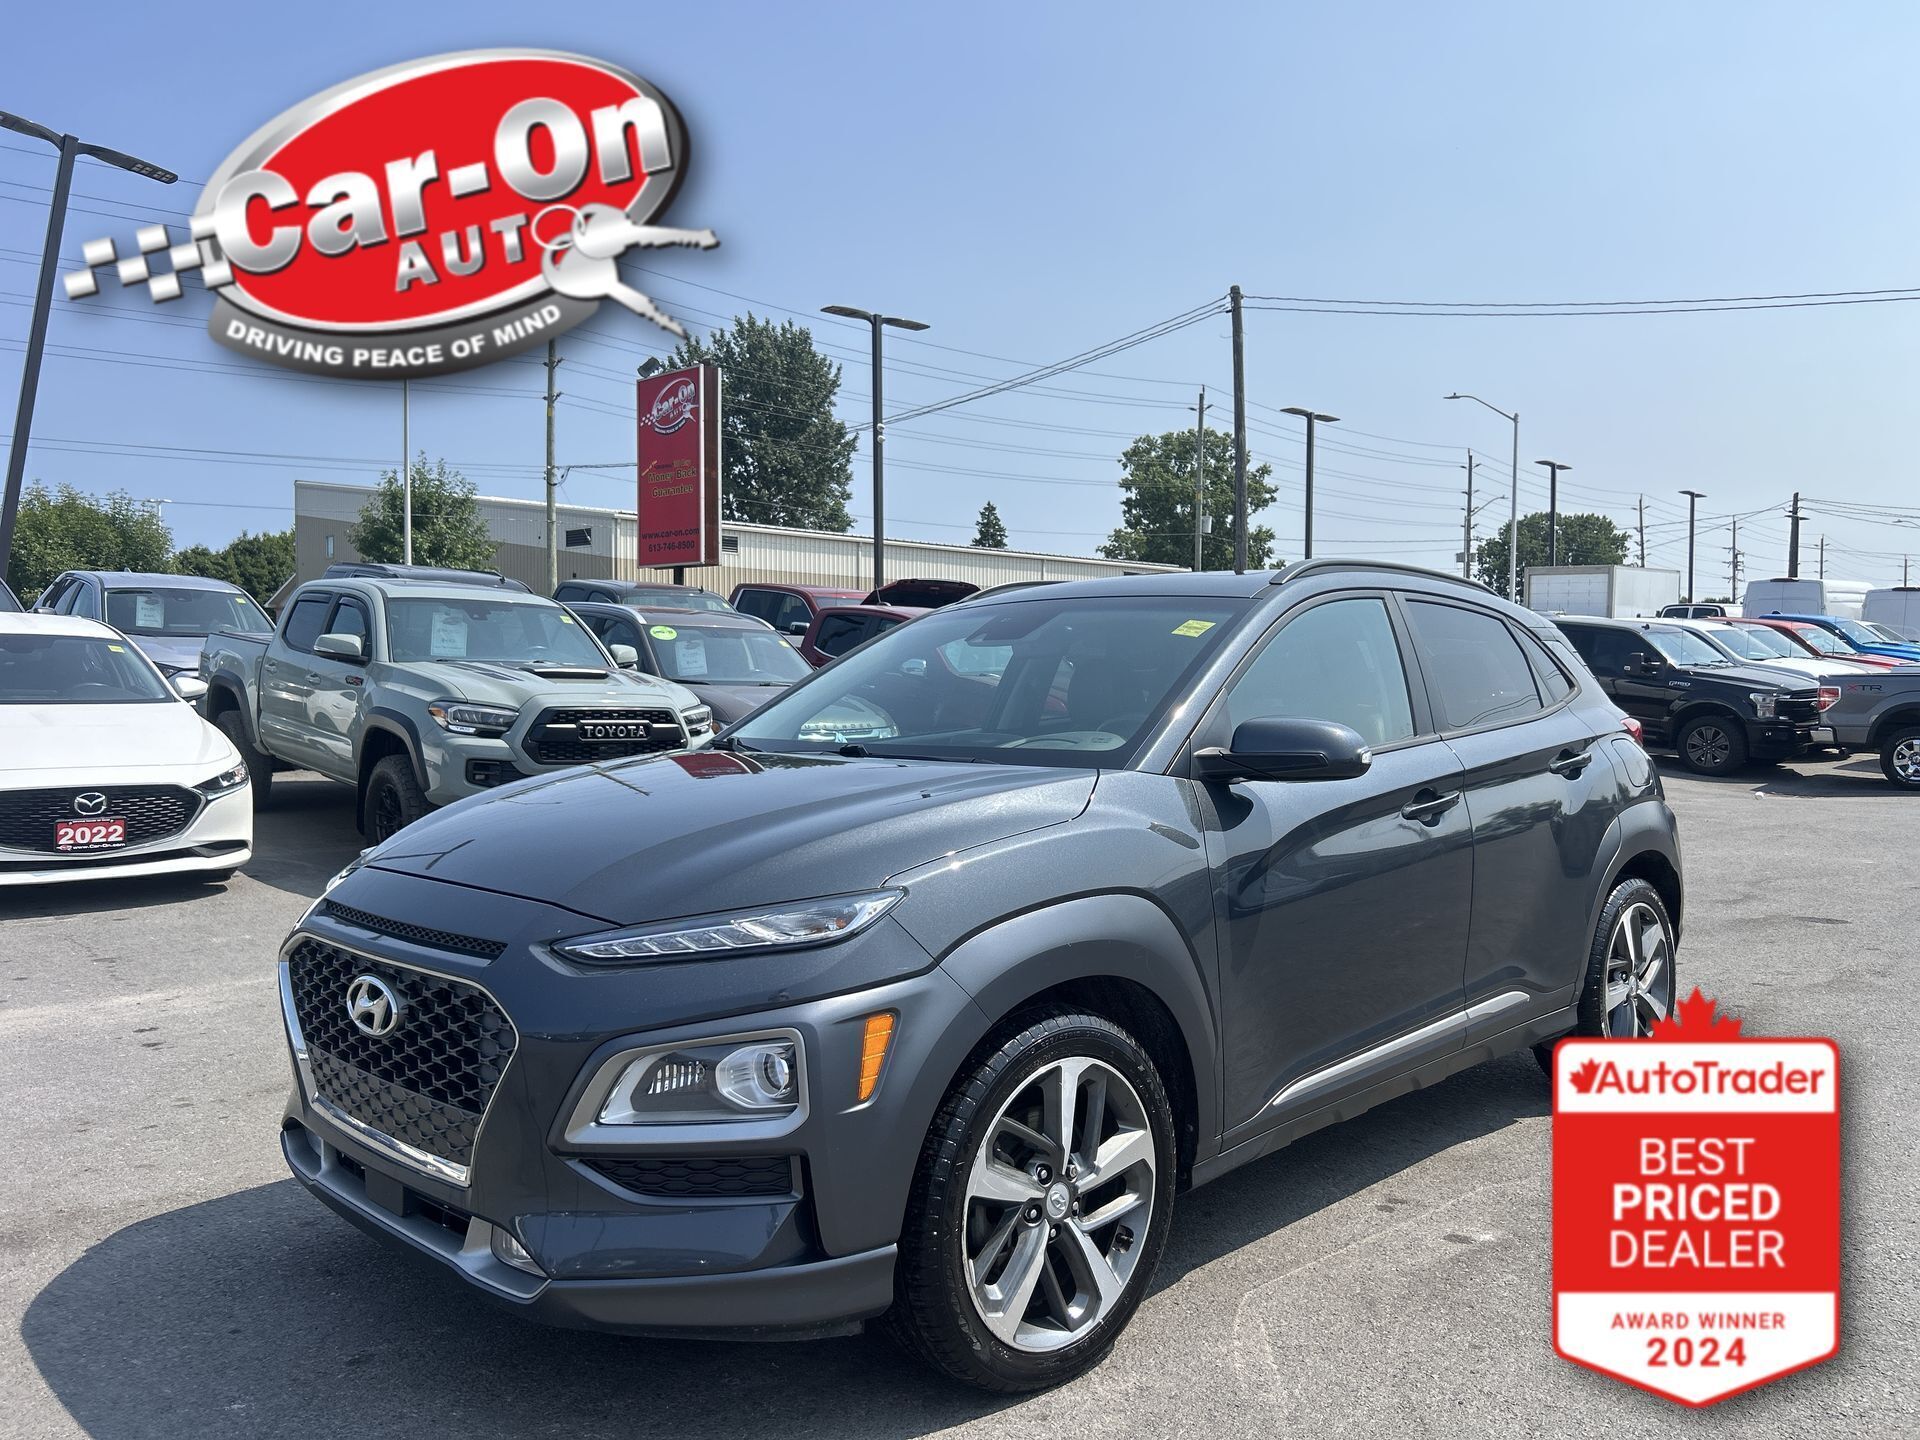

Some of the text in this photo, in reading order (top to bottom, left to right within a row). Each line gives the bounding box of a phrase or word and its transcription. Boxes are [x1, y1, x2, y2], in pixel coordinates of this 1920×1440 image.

[648, 466, 696, 483] Money Back
[652, 484, 693, 498] Guarantee
[641, 528, 700, 539] www.car-on.com
[1847, 684, 1882, 692] XTR
[584, 725, 647, 737] TOYOTA
[58, 825, 123, 844] 2022
